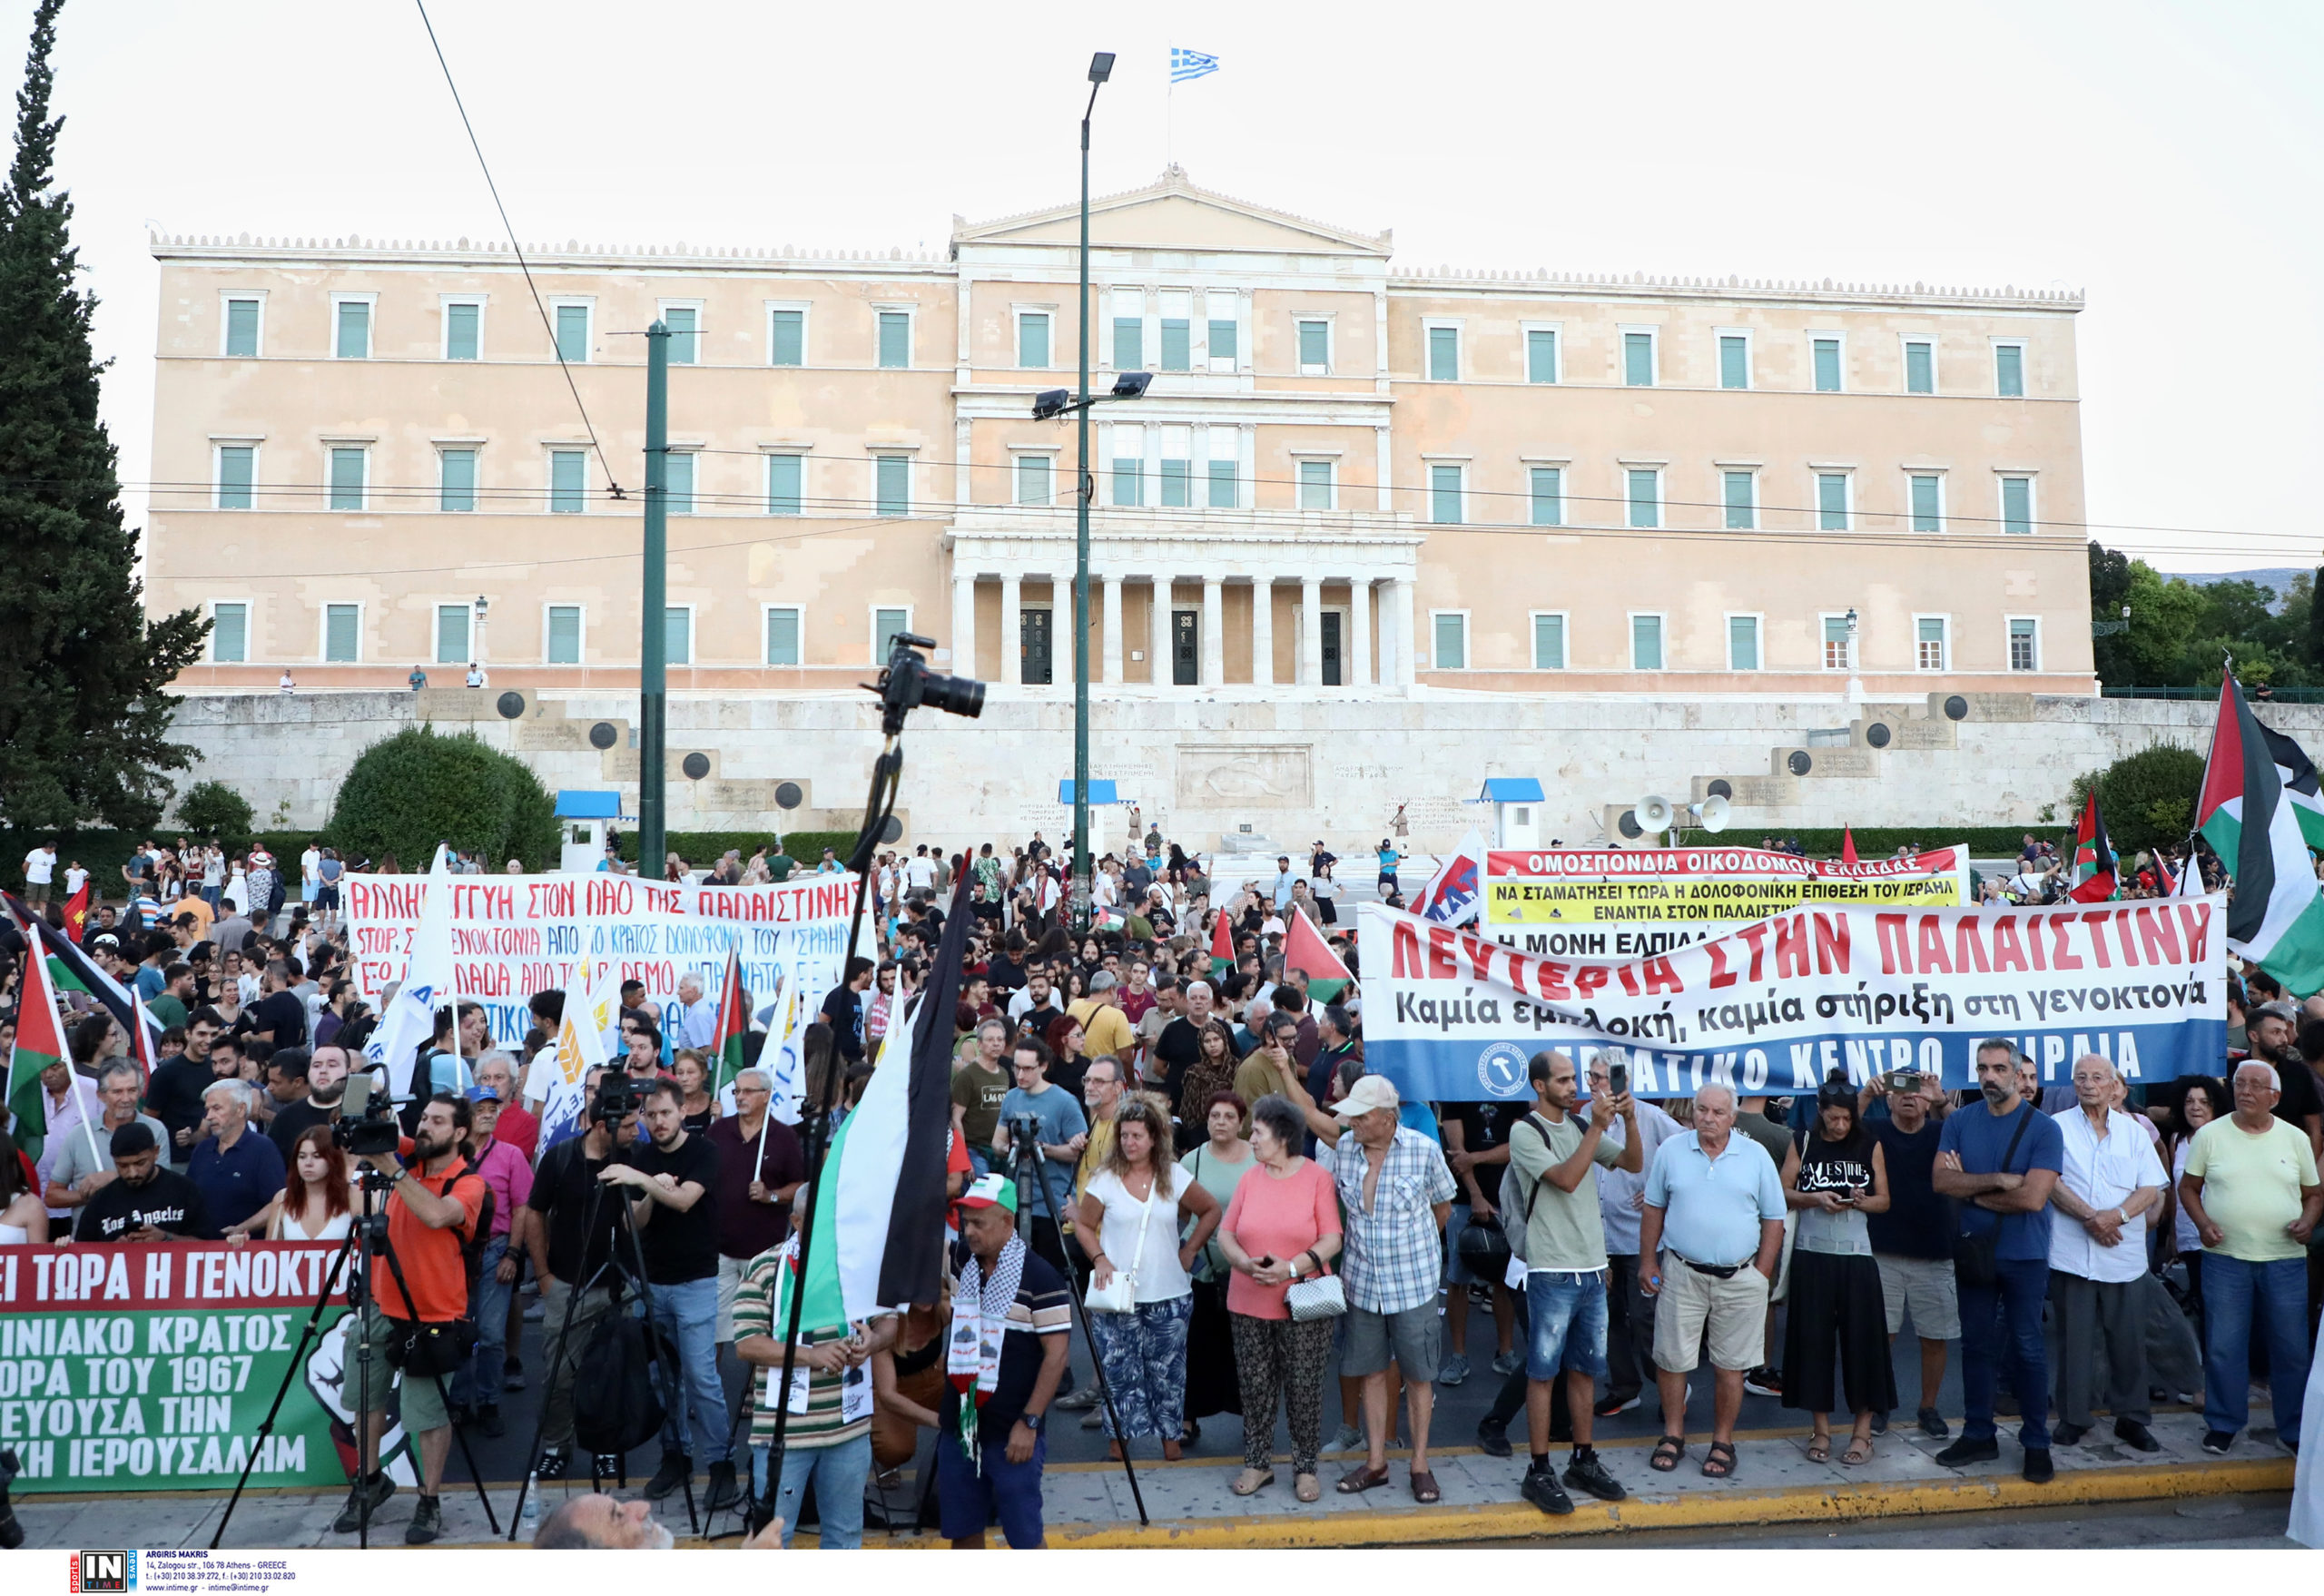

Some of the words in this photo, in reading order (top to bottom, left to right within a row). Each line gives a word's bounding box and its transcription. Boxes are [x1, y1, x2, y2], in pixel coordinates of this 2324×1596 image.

[1528, 852, 1678, 873] ΟΜΟΣΠΟΝΔΙΑ
[1687, 852, 1818, 876] ΟΙΚΟΔΟΜΩΝ
[1825, 857, 1922, 877] ΕΛΛΑΔΑΣ
[350, 882, 513, 921] ΑΛΛΗΓΓΥΗ
[528, 882, 574, 919] ΣΤΟΝ
[647, 887, 684, 915] ΤΗΣ
[1496, 885, 1517, 901] ΝΑ
[1523, 885, 1622, 901] ΣΤΑΜΑΤΗΣΕΙ
[1630, 884, 1669, 901] ΤΩΡΑ
[1674, 884, 1686, 899] Η
[1690, 883, 1797, 899] ΔΟΛΟΦΟΝΙΚΗ
[1802, 883, 1868, 898] ΕΠΙΘΕΣΗ
[1875, 883, 1900, 898] ΤΟΥ
[1903, 881, 1954, 898] ΙΣΡΑΗΛ
[1594, 904, 1662, 921] ΕΝΑΝΤΙΑ
[1667, 903, 1709, 920] ΣΤΟΝ
[452, 928, 541, 955] ΕΝΟΚΤΟΝΙΑ
[548, 925, 579, 956] ΑΠΟ
[611, 924, 657, 955] ΚΡΑΤΟΣ
[752, 928, 781, 955] ΤΟΥ
[1392, 921, 1685, 1000] ΛΕΥΤΕΡΙΑ
[1708, 911, 1851, 990] ΣΤΗΝ
[1876, 902, 2211, 975] ΠΑΛΑΙΣΤΙΝΗ
[1526, 933, 1606, 955] ΜΟΝΗ
[1397, 986, 1501, 1031] Καμία
[1699, 987, 1806, 1036] καμία
[1816, 980, 1954, 1025] στήριξη
[1964, 993, 2022, 1021] στη
[1789, 1037, 1943, 1089] ΚΕΝΤΡΟ
[102, 1217, 125, 1235] Los
[132, 1206, 184, 1225] Angeles
[33, 1252, 130, 1301] ΤΩΡΑ
[144, 1253, 172, 1299] Η
[184, 1249, 361, 1299] ΓΕΝΟΚΤΟ
[148, 1315, 292, 1354] ΚΡΑΤΟΣ
[84, 1357, 157, 1395] ΤΟΥ
[169, 1355, 254, 1394] 1967
[0, 1397, 145, 1437] ΕΥΟΥΣΑ
[159, 1395, 231, 1433] ΤΗΝ
[69, 1434, 307, 1477] ΙΕΡΟΥΣΑΛΗΜ
